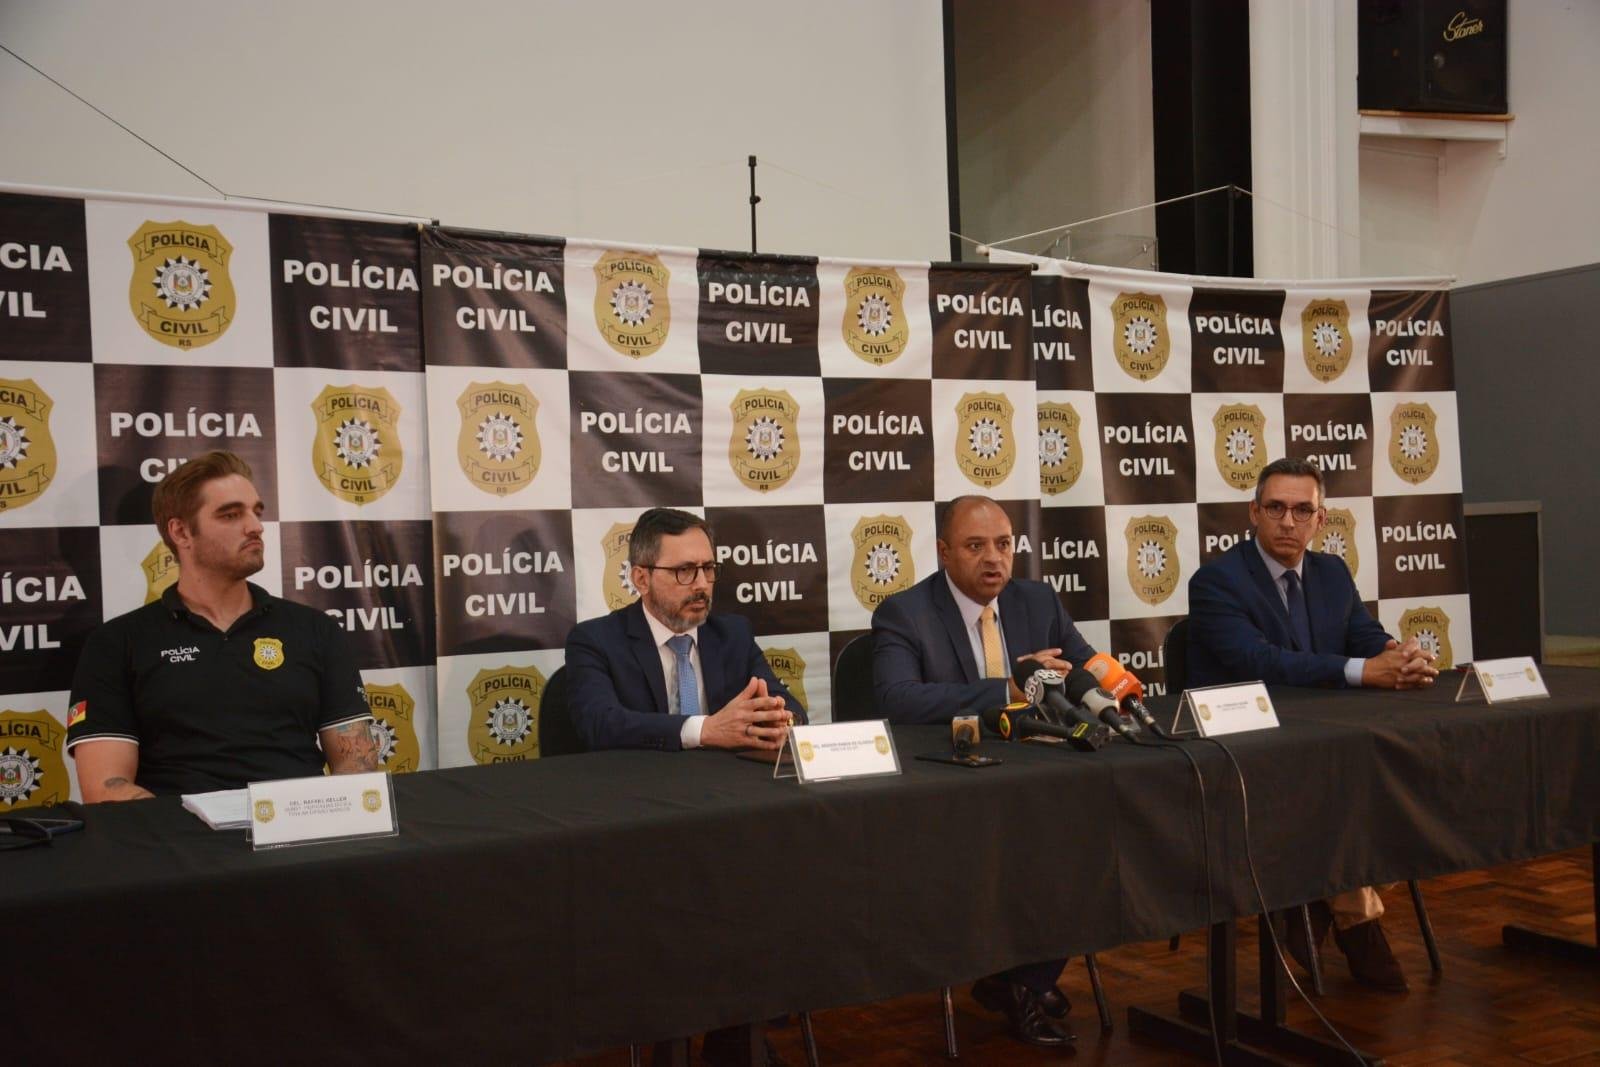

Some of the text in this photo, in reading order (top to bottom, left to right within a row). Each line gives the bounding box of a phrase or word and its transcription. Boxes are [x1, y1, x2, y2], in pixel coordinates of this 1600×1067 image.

[151, 231, 210, 250] POLÍCIA
[283, 258, 419, 291] POLÍCIA
[610, 259, 654, 276] POLÍCIA
[432, 262, 554, 293] POLÍCIA
[857, 276, 892, 289] POLÍCIA
[709, 280, 811, 307] POLÍCIA
[937, 292, 1024, 316] POLÍCIA
[1123, 300, 1154, 312] POLÍCIA
[309, 306, 398, 333] CIVIL
[456, 308, 535, 332] CIVIL
[1312, 307, 1340, 319] POLÍCIA
[160, 320, 208, 335] CIVIL
[1196, 313, 1274, 335] POLÍCIA
[1376, 318, 1444, 337] POLÍCIA
[617, 334, 652, 346] CIVIL
[726, 322, 792, 344] CIVIL
[954, 329, 1011, 350] CIVIL
[178, 338, 192, 347] RS
[861, 342, 893, 354] CIVIL
[1213, 347, 1265, 366] CIVIL
[1386, 349, 1433, 366] CIVIL
[1129, 362, 1154, 371] CIVIL
[1316, 364, 1338, 372] CIVIL
[331, 394, 380, 412] POLÍCIA
[475, 390, 521, 406] POLÍCIA
[744, 396, 785, 412] POLÍCIA
[967, 400, 1002, 413] POLÍCIA
[110, 407, 262, 437] POLÍCIA
[581, 408, 692, 434] POLÍCIA
[832, 411, 924, 435] POLÍCIA
[1224, 411, 1255, 422] POLÍCIA
[1399, 410, 1426, 419] POLÍCIA
[1104, 422, 1187, 443] POLÍCIA
[1291, 421, 1367, 442] POLÍCIA
[602, 451, 674, 472] CIVIL
[848, 451, 910, 470] CIVIL
[1119, 458, 1175, 475] CIVIL
[481, 470, 521, 482] CIVIL
[749, 469, 781, 480] CIVIL
[973, 467, 1001, 478] CIVIL
[1231, 471, 1256, 480] CIVIL
[1402, 466, 1426, 474] CIVIL
[340, 477, 376, 490] CIVIL
[865, 522, 900, 537] POLÍCIA
[1134, 523, 1166, 534] POLÍCIA
[1382, 522, 1457, 543] POLÍCIA
[716, 540, 818, 565] POLÍCIA
[443, 548, 564, 576] POLÍCIA
[1395, 554, 1445, 572] CIVIL
[295, 559, 423, 590] POLÍCIA
[736, 581, 802, 603] CIVIL
[1142, 586, 1165, 595] CIVIL
[465, 593, 545, 617] CIVIL
[1409, 614, 1439, 626] POLÍCIA
[161, 646, 200, 658] POLÍCIA
[170, 653, 196, 663] CIVIL
[484, 676, 531, 691] POLÍCIA
[1025, 676, 1038, 704] sbt
